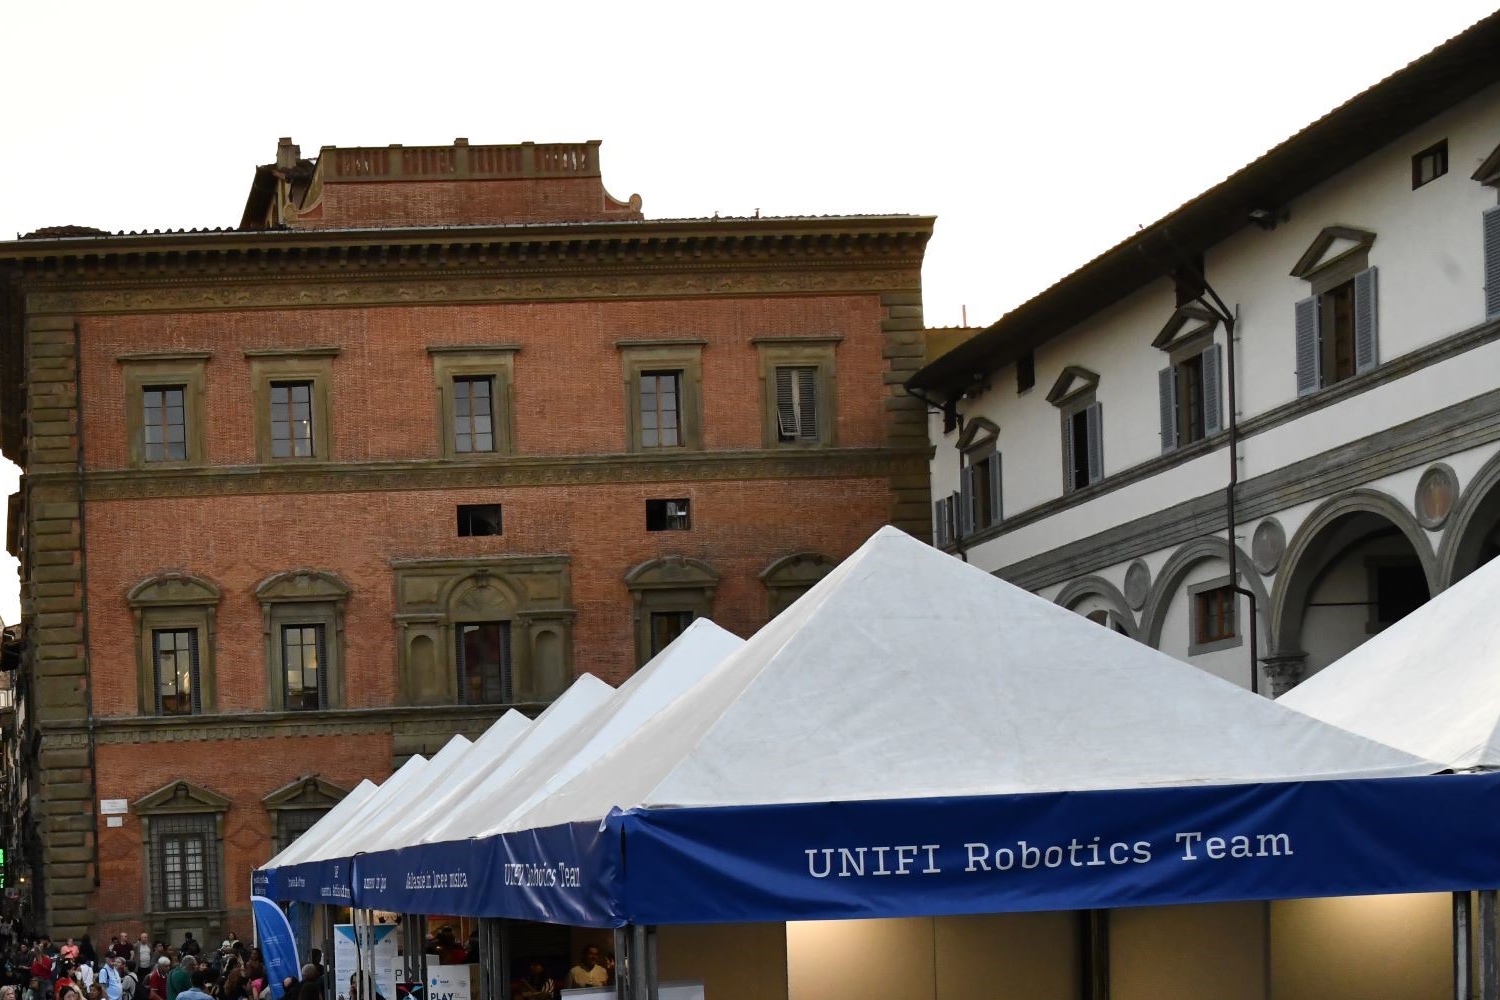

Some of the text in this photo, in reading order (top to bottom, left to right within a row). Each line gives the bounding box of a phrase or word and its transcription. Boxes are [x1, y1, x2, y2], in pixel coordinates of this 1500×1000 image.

[805, 831, 1294, 878] UNIFI Robotics Team
